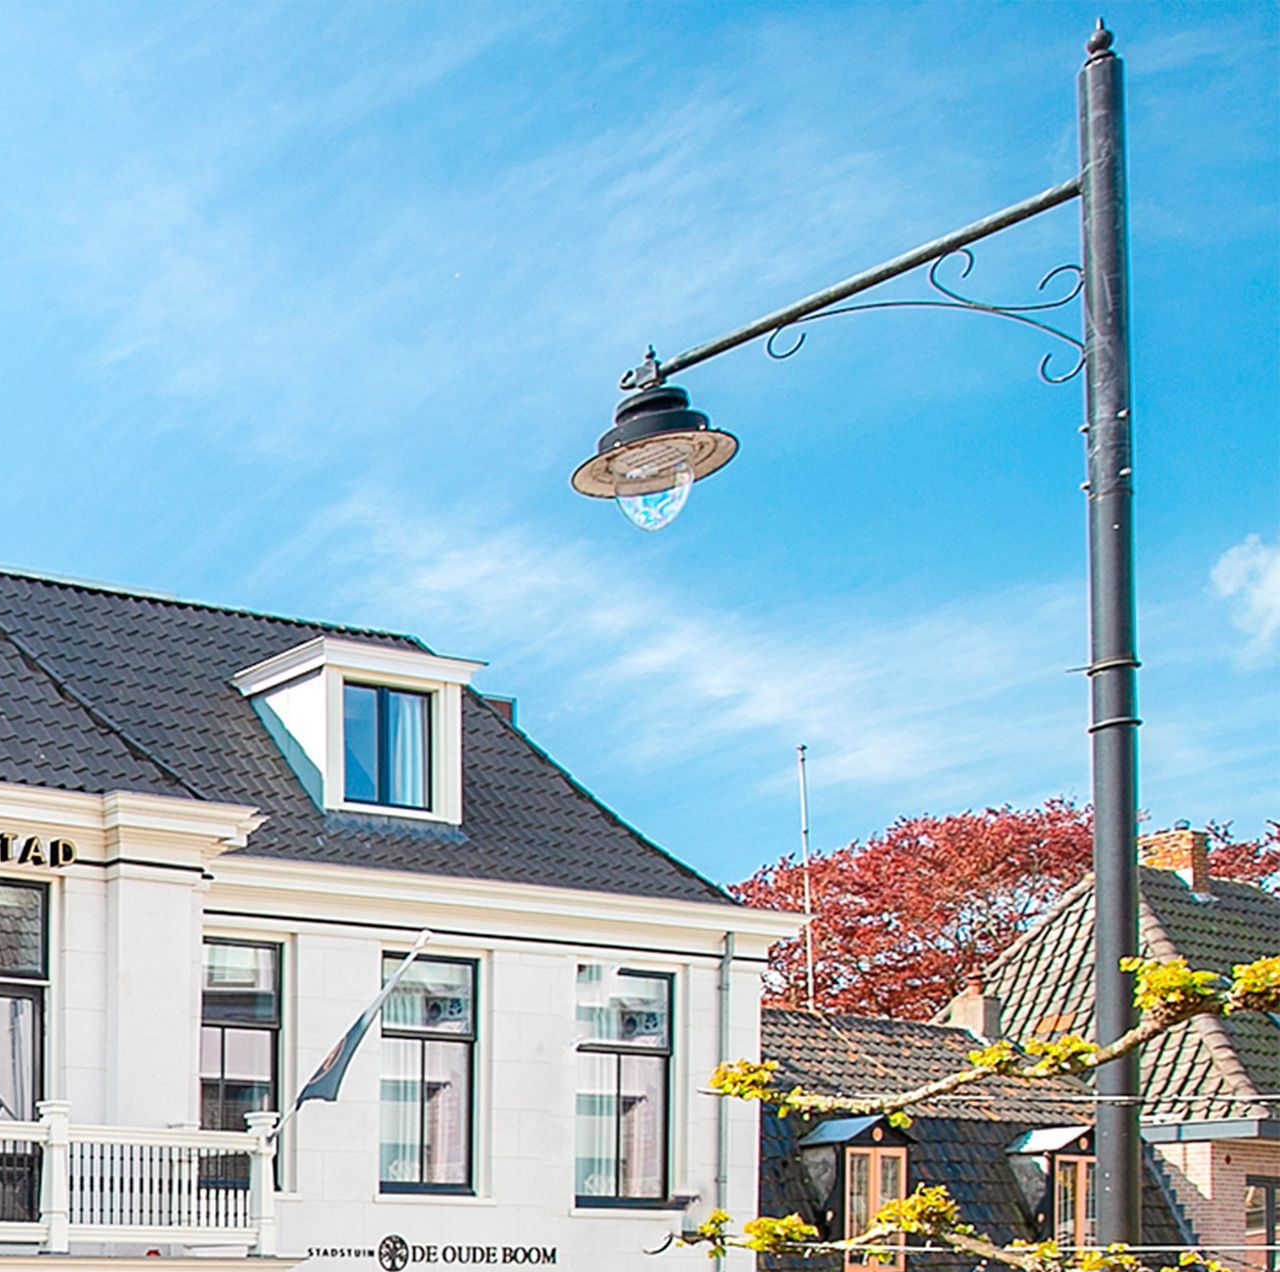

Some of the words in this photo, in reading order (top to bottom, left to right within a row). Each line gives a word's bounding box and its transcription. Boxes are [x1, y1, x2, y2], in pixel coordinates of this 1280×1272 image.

[411, 1245, 439, 1263] DE
[442, 1246, 498, 1264] OUDE
[502, 1247, 557, 1265] BOOM
